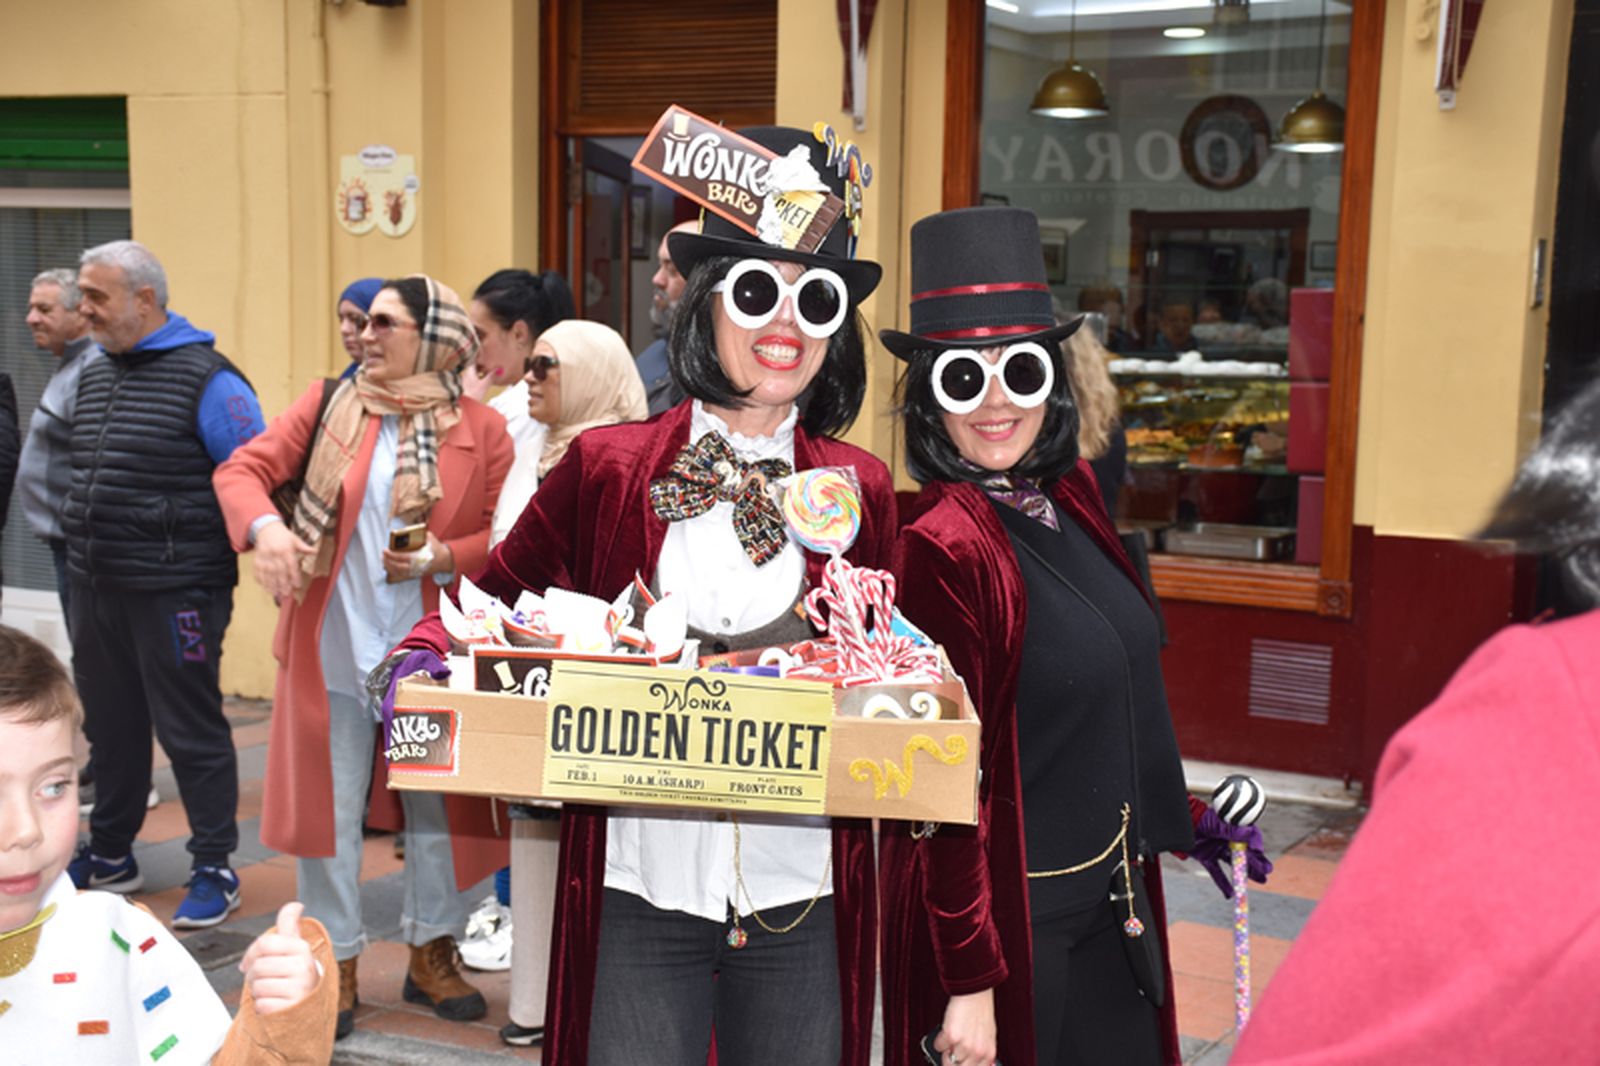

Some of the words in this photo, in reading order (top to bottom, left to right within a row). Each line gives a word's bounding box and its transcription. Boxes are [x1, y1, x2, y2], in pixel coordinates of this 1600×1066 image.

[662, 132, 771, 197] WONK
[707, 182, 757, 215] BAR
[774, 197, 812, 229] CKET
[176, 610, 206, 662] EA7
[649, 676, 732, 712] WONKA
[390, 715, 440, 744] NKA
[550, 704, 690, 761] GOLDEN
[701, 716, 827, 771] TICKET
[390, 743, 428, 761] BAR
[623, 774, 634, 785] 10
[659, 776, 705, 790] (SHARP)
[729, 782, 767, 794] FRONT
[768, 785, 803, 796] GATES
